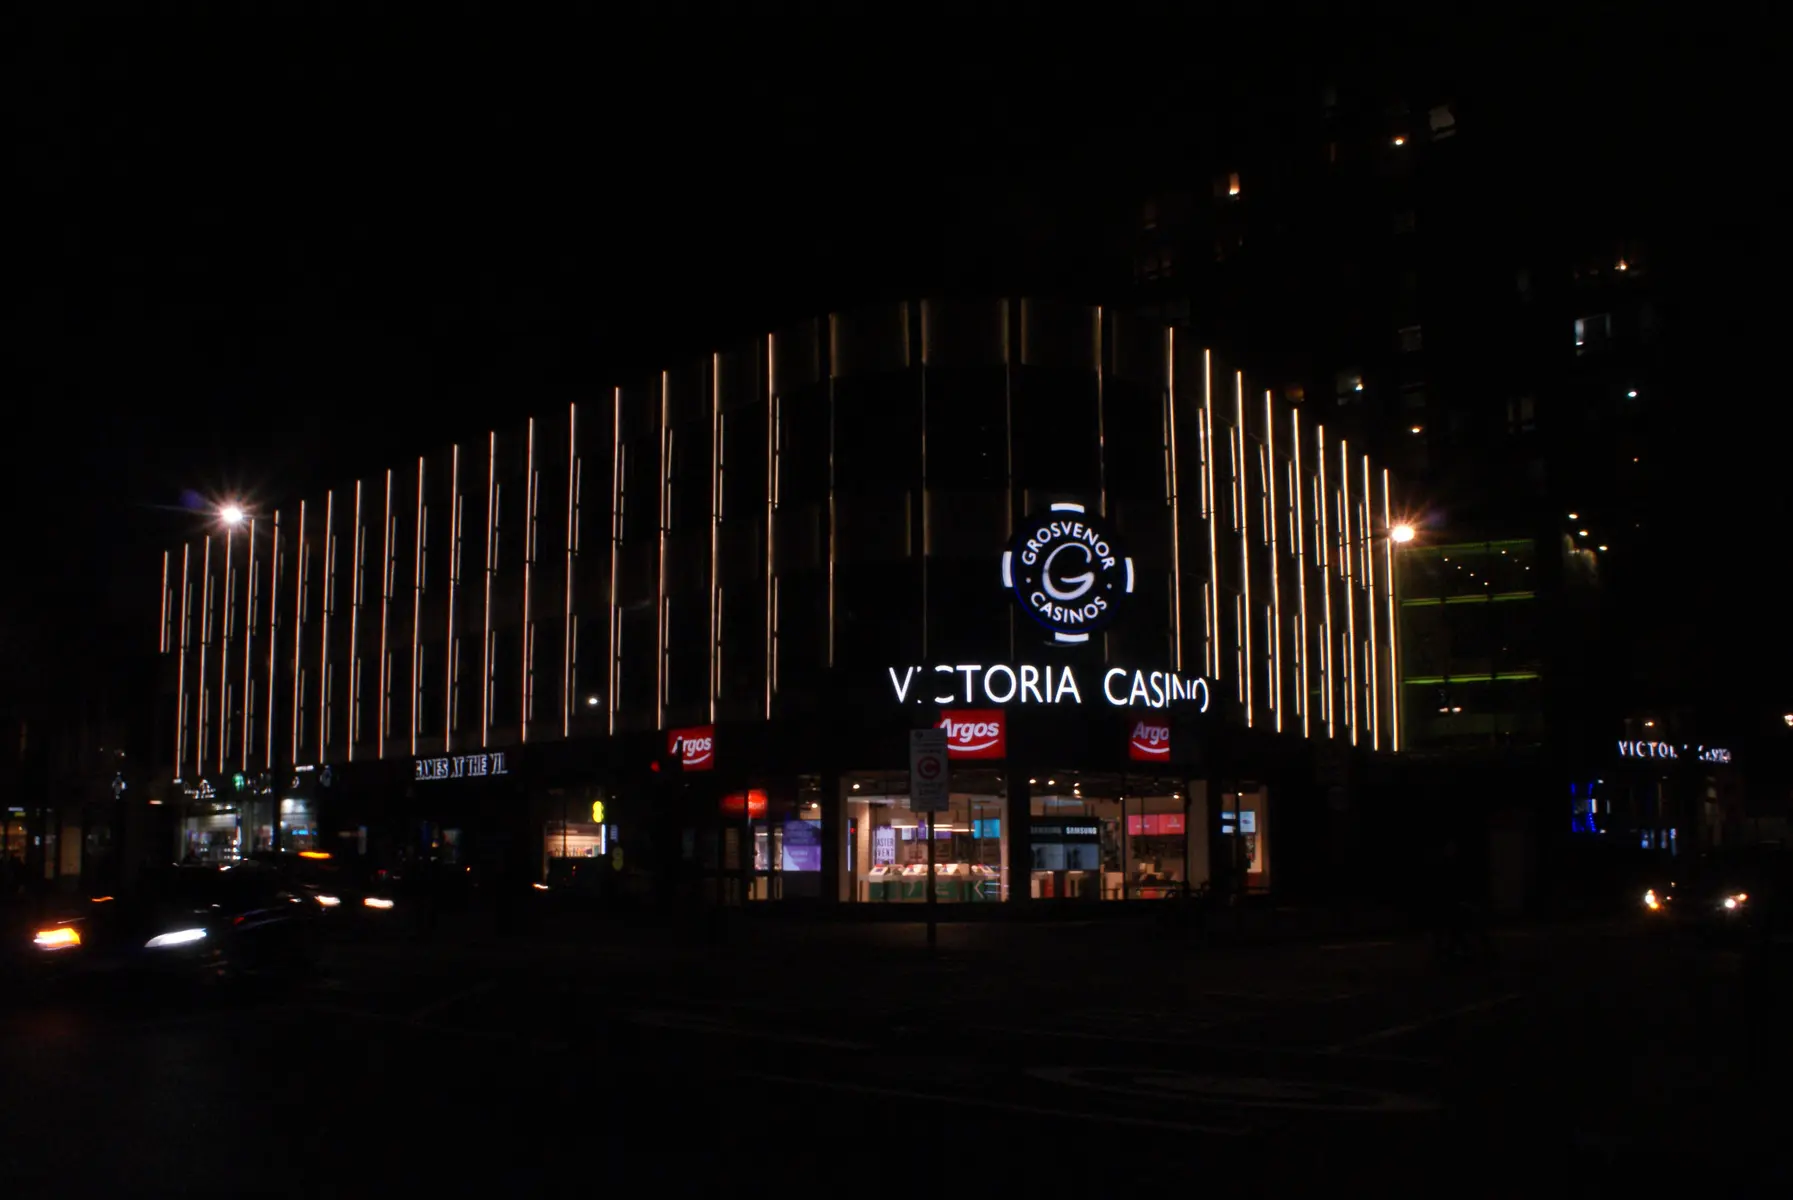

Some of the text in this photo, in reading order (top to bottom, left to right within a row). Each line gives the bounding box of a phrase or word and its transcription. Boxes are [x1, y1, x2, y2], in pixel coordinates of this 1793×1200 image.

[1022, 521, 1115, 570] GROSVENOR
[1042, 542, 1095, 600] G
[1031, 591, 1107, 623] CASINOS
[888, 664, 1082, 704] VCTORIA
[940, 718, 1000, 743] Argos
[1133, 721, 1169, 745] Argo
[466, 754, 488, 777] THE
[1066, 826, 1098, 834] SAMSUNG
